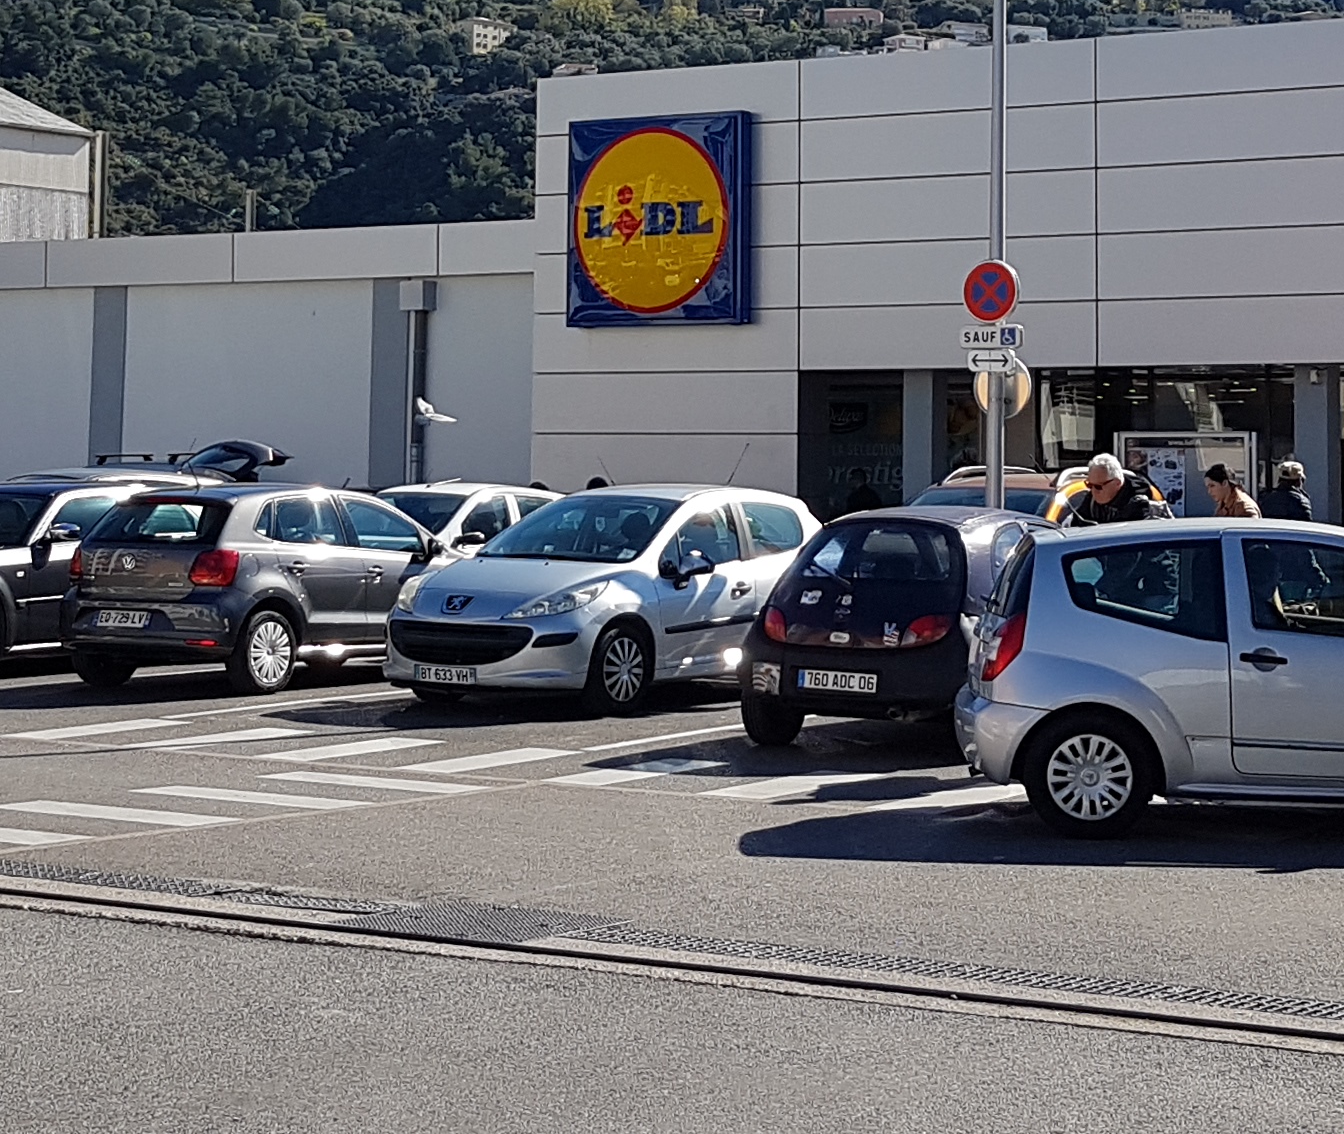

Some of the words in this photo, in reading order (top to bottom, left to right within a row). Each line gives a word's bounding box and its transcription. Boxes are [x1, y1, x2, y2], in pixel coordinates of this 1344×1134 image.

[963, 331, 997, 343] SAUF
[807, 671, 829, 687] 760
[832, 674, 855, 689] ADC
[858, 676, 875, 690] 06
